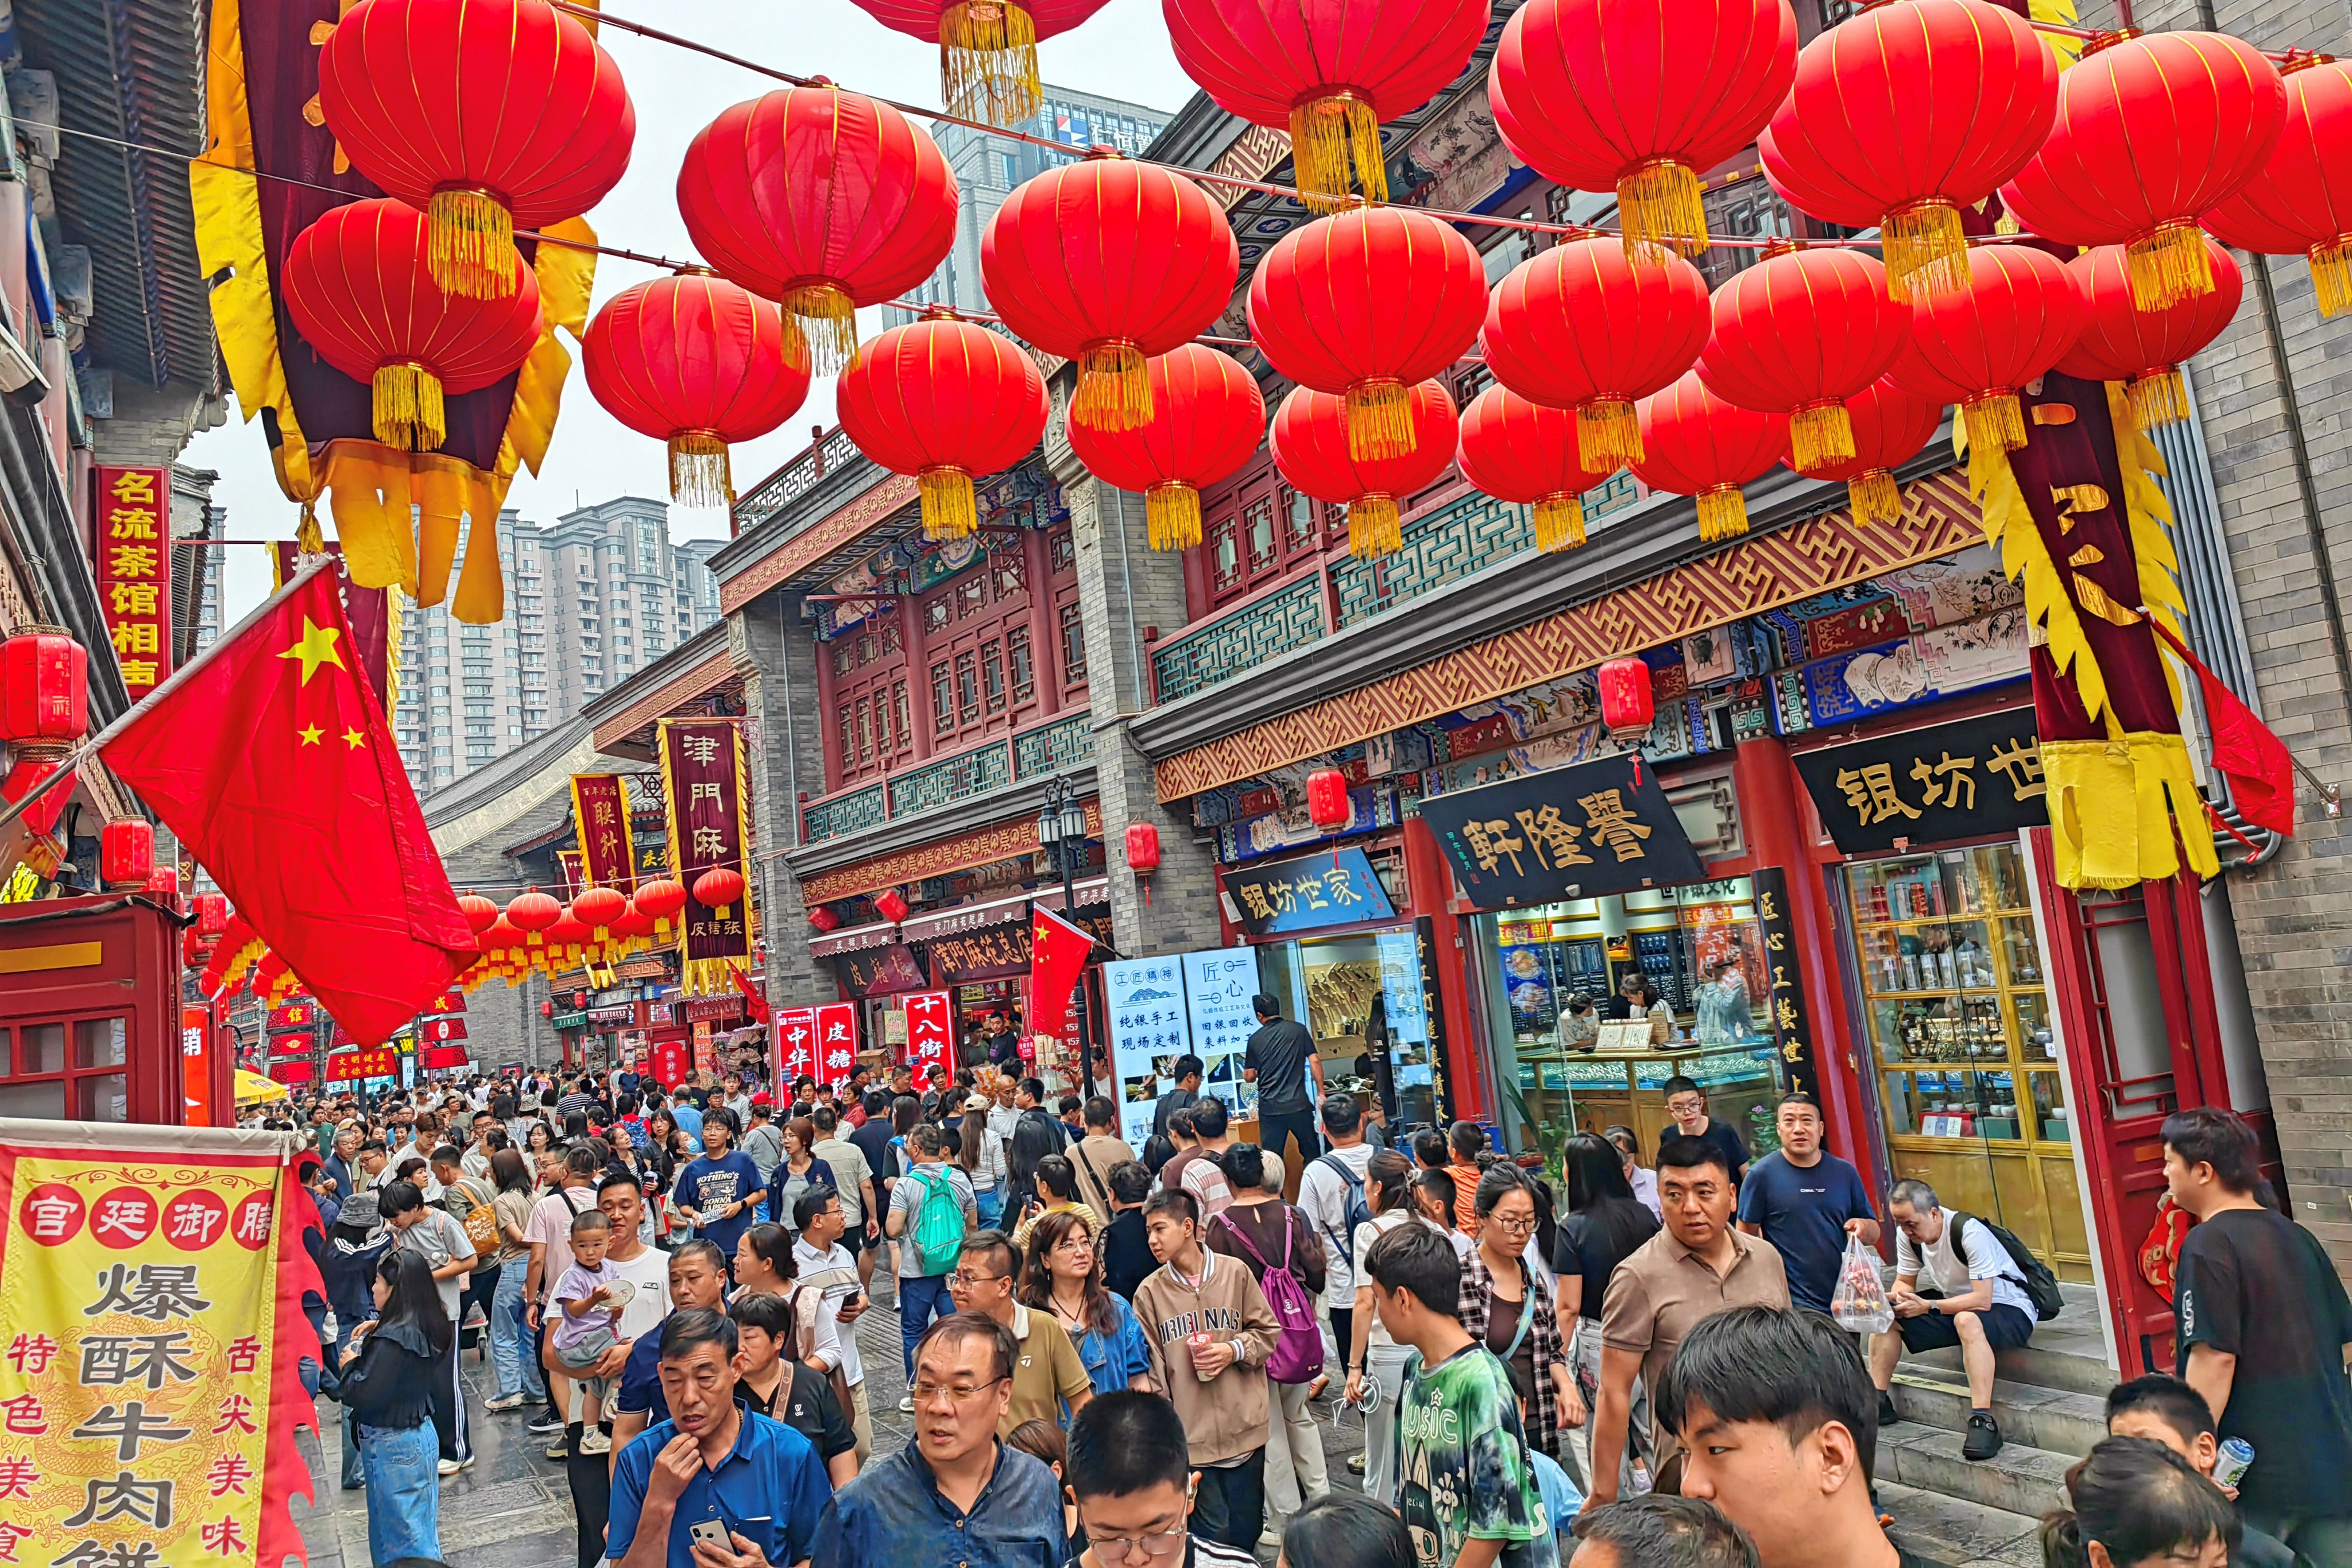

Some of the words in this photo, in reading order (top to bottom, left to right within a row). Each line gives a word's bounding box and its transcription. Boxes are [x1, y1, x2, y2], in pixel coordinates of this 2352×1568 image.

[110, 471, 158, 686] 名流茶馆相声
[1240, 867, 1363, 920] 银坊世家
[1115, 966, 1174, 986] 工匠精神
[1119, 1011, 1179, 1029] 纯银手工
[1202, 1016, 1254, 1031] 旧银回收
[914, 997, 945, 1093] 十八街
[1121, 1031, 1181, 1051] 现场定制
[338, 1052, 386, 1066] 文明健康
[338, 1063, 388, 1078] 有你有我
[697, 1171, 739, 1184] NOTHING'S
[29, 1194, 272, 1245] 宫廷御膳
[0, 1332, 59, 1563] 特色美食
[200, 1334, 262, 1558] 舌尖美味
